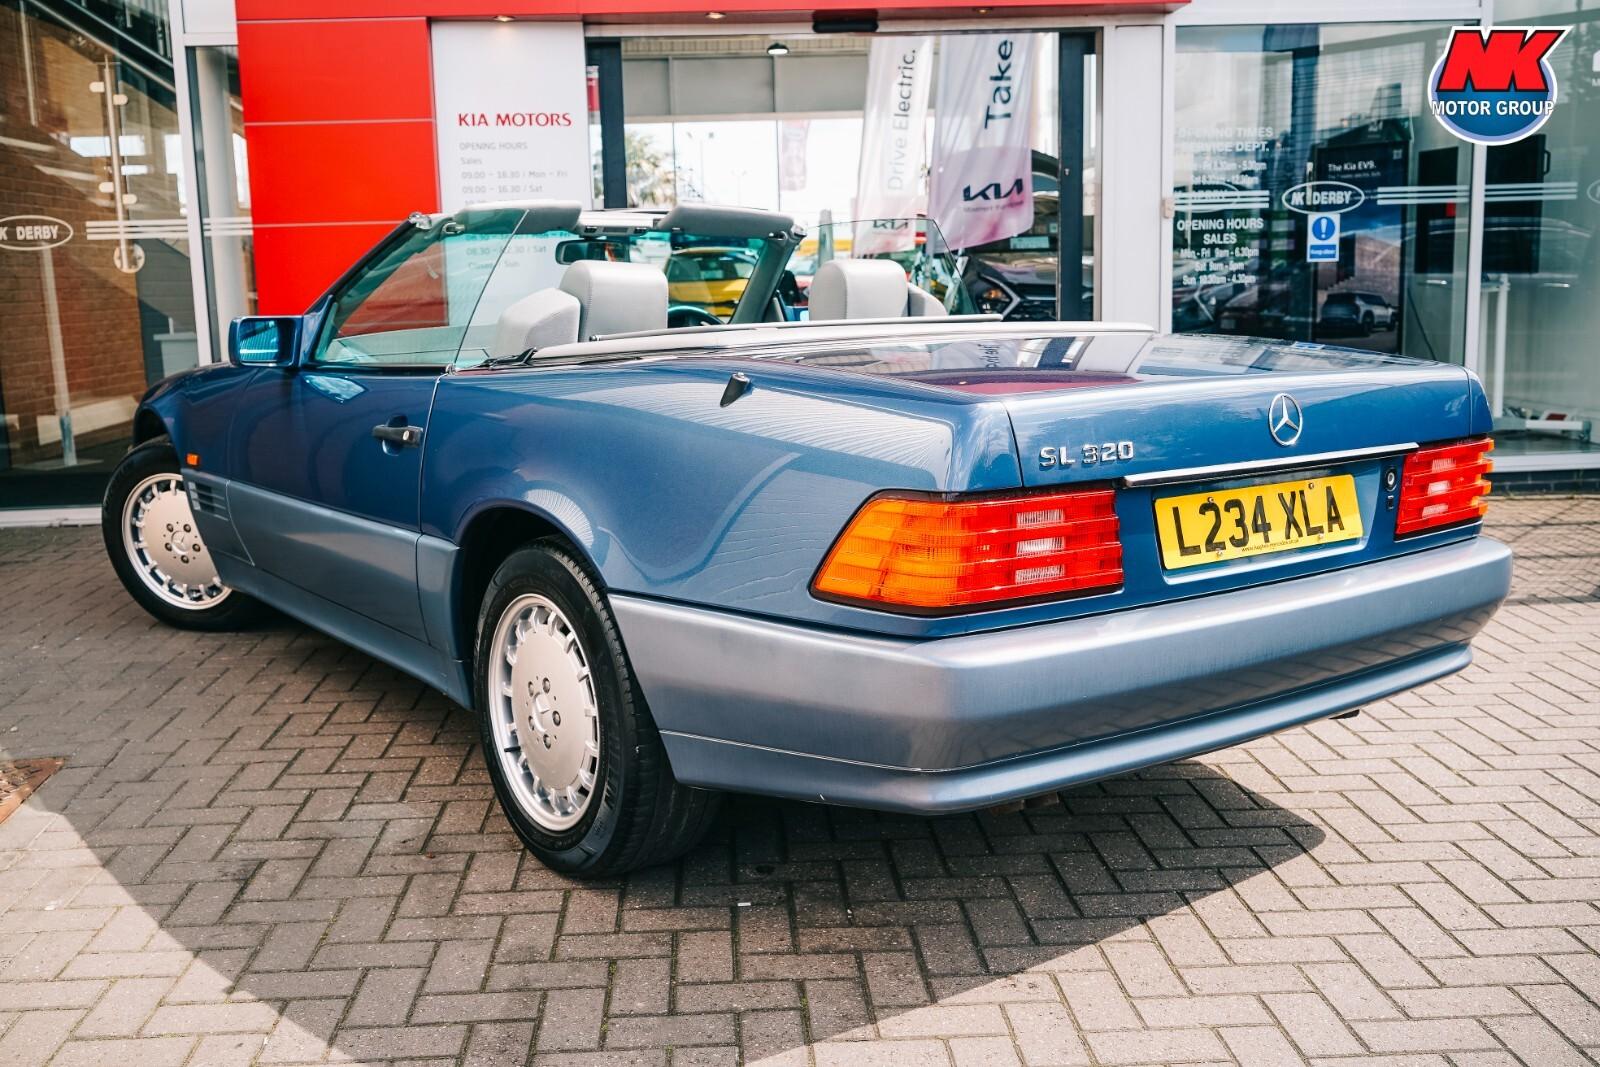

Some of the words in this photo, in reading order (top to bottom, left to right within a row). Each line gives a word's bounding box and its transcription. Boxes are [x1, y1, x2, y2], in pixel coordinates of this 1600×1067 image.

[984, 39, 1014, 129] Take
[893, 49, 917, 132] Electric.
[458, 112, 488, 127] KIA
[496, 112, 572, 127] MOTORS
[1236, 126, 1274, 138] TIMES
[459, 142, 497, 151] OPENING
[499, 142, 528, 150] HOURS
[1236, 141, 1270, 152] DEPT.
[460, 157, 482, 165] Sales
[888, 137, 909, 190] Drive
[1328, 163, 1343, 172] The
[1343, 162, 1357, 171] Kia
[556, 170, 569, 178] Fri
[529, 185, 543, 193] Sat
[1313, 190, 1353, 205] DERBY
[1177, 219, 1224, 231] OPENING
[1226, 217, 1264, 230] HOURS
[16, 225, 58, 240] DERBY
[1203, 233, 1237, 245] SALES
[1201, 247, 1211, 258] Fri
[1183, 275, 1196, 285] Sun
[1039, 446, 1076, 468] SL
[1081, 440, 1134, 465] 320
[1172, 495, 1271, 557] L234
[1278, 485, 1345, 540] XLA
